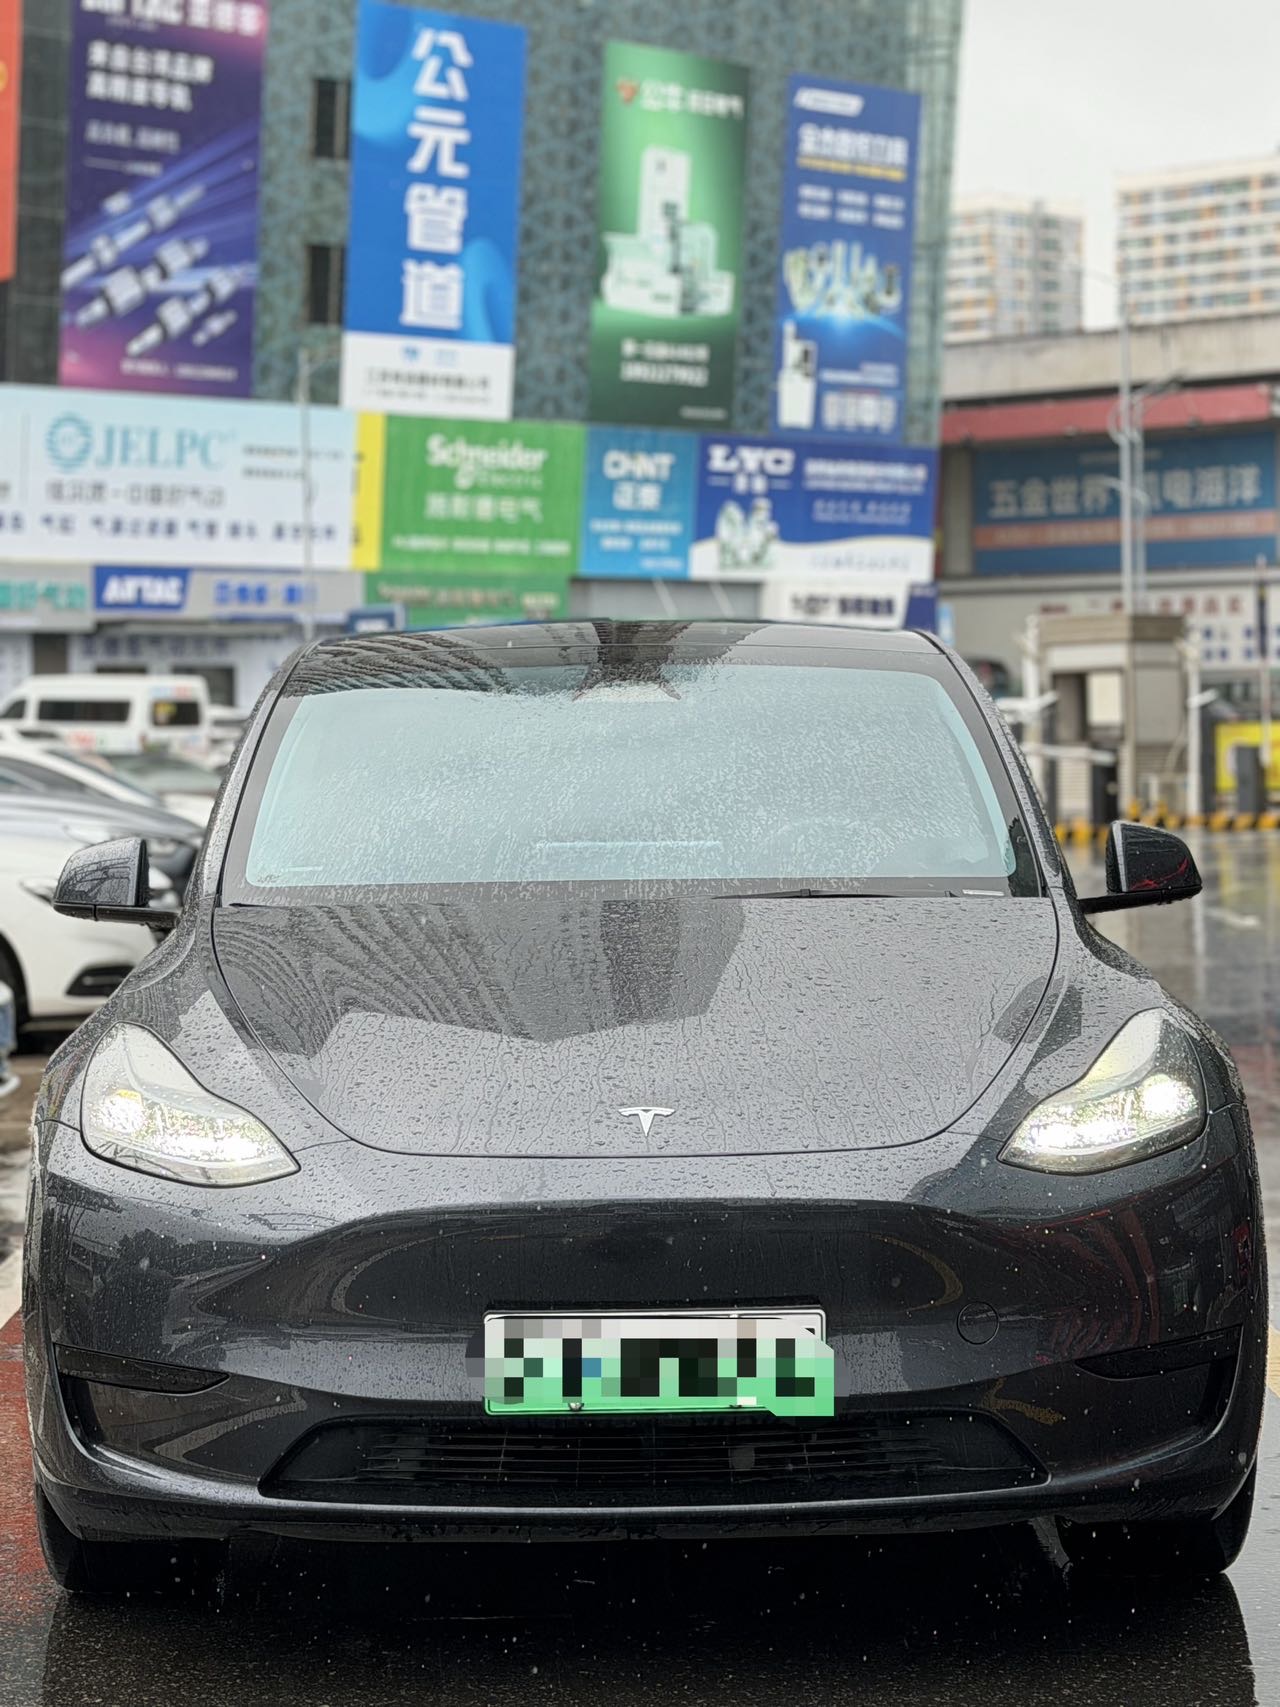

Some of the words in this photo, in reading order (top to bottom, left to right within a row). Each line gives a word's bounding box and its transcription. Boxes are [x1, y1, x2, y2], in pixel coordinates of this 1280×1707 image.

[399, 27, 473, 330] 公元管道
[95, 424, 229, 471] JELPC
[426, 433, 549, 476] Schneider
